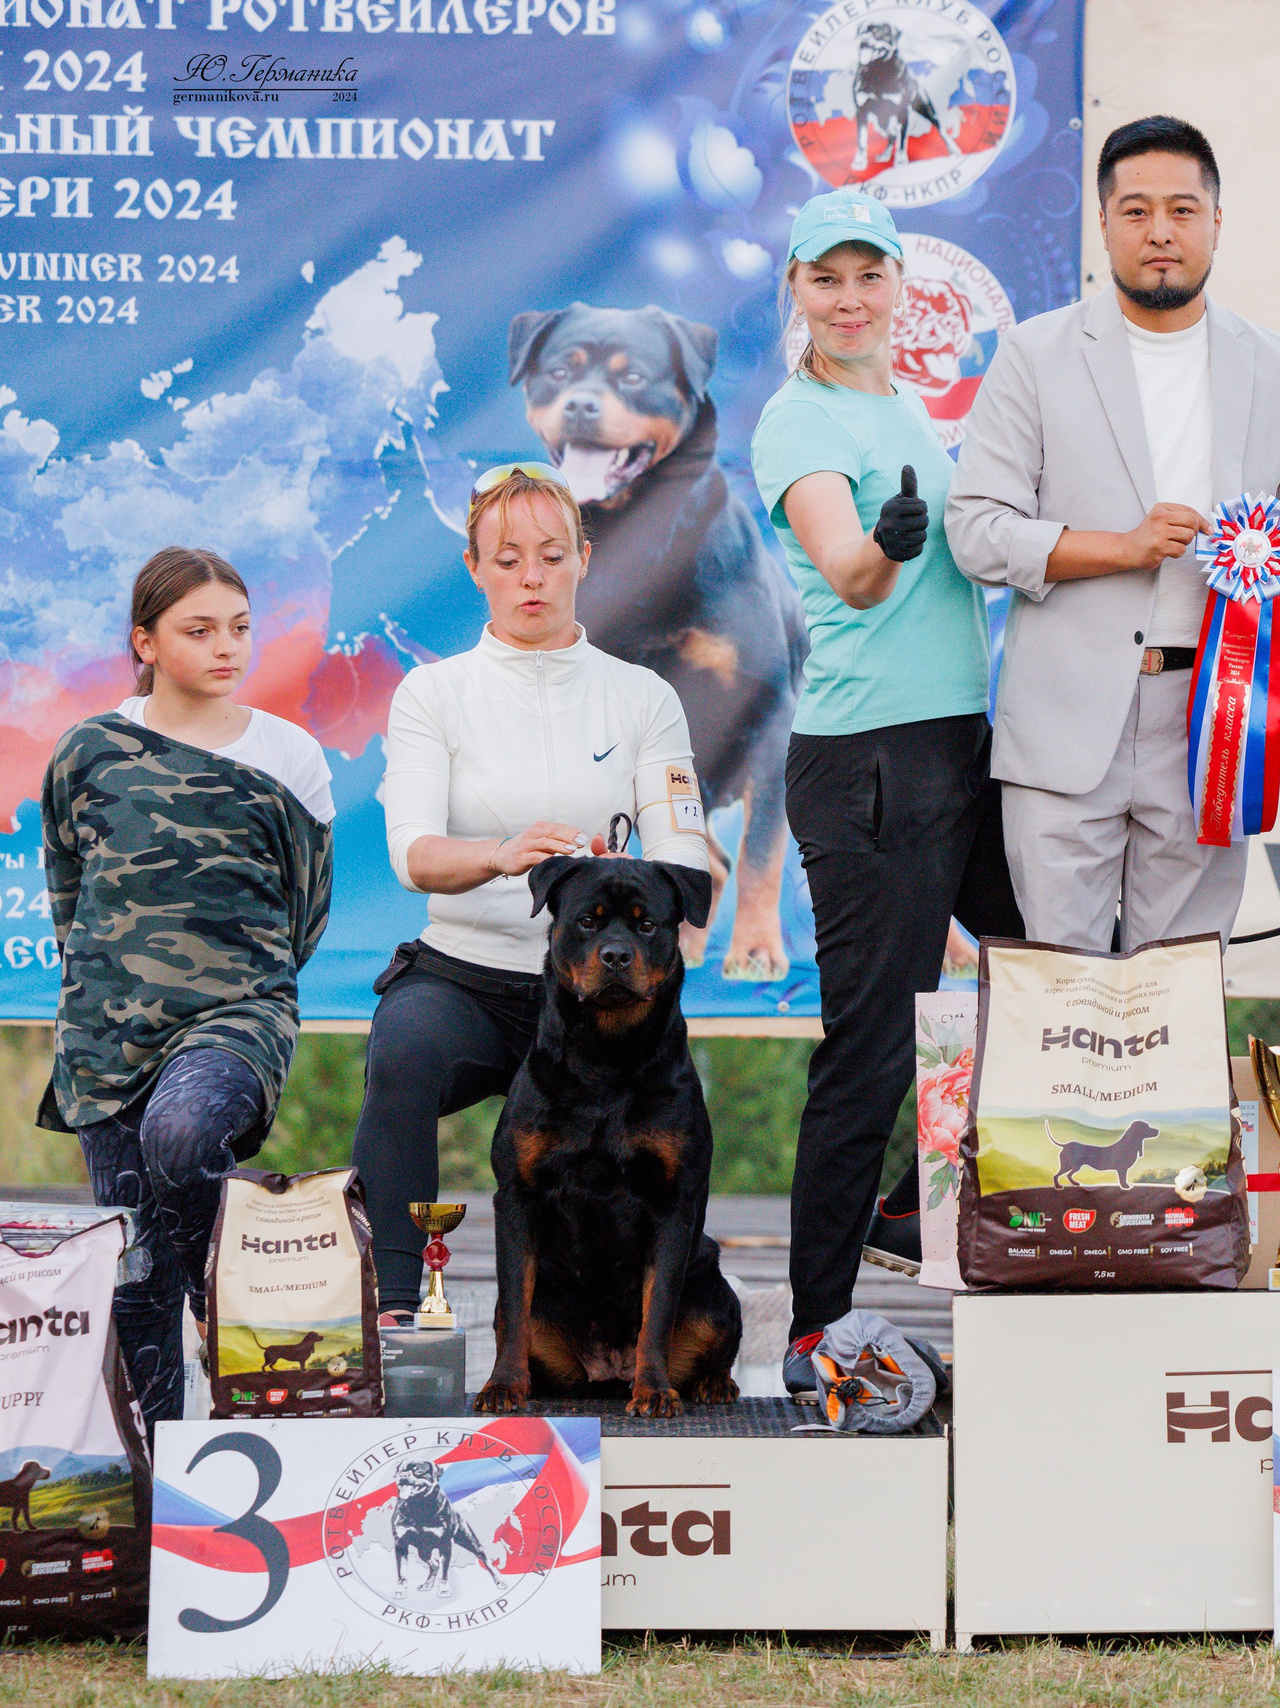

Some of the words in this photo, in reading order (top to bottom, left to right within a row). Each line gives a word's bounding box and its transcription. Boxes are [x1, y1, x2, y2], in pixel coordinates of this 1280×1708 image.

[23, 50, 148, 92] 2024
[173, 116, 556, 161] ЧЕМПИОНАТ
[114, 178, 237, 220] 2024
[157, 254, 240, 283] 2024
[916, 236, 1010, 332] НАЦИОНАЛЬ
[56, 295, 139, 324] 2024
[1210, 748, 1230, 830] Победитель
[1224, 695, 1237, 742] класса
[0, 886, 52, 919] 24
[1121, 1006, 1150, 1020] рисом
[1041, 1024, 1169, 1059] Hanta
[1082, 1056, 1131, 1072] premium
[1051, 1081, 1158, 1102] SMALL/MEDIUM
[1069, 1212, 1091, 1220] FRESH
[1069, 1221, 1087, 1229] MEAT
[241, 1231, 337, 1254] Hanta
[27, 1267, 62, 1281] рисом
[248, 1280, 327, 1294] SMALL/MEDIUM
[326, 1435, 419, 1579] РОТВЕЙЛЕР
[437, 1430, 513, 1463] КЛУБ
[521, 1468, 558, 1578] РОССИИ
[179, 1431, 290, 1634] 3
[381, 1597, 511, 1630] РКФ-НКПР
